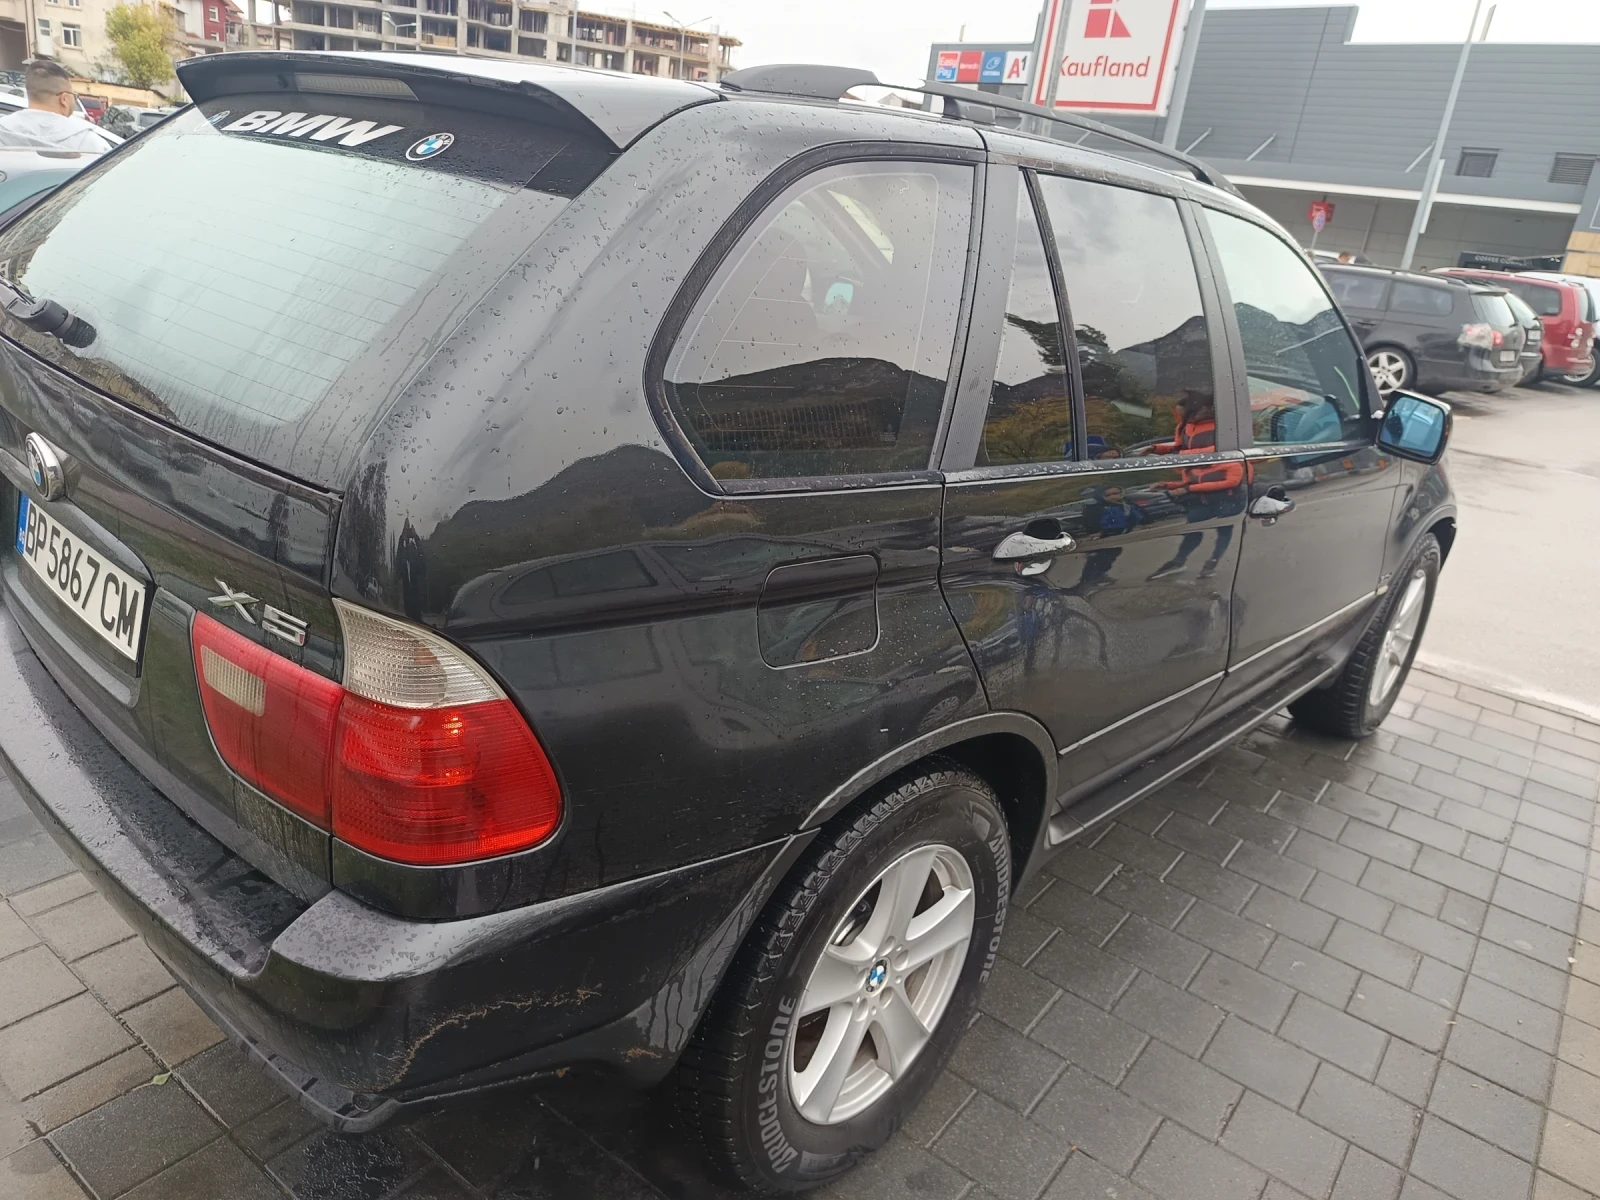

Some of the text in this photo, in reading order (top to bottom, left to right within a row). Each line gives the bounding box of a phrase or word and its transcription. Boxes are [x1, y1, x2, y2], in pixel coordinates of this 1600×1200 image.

[220, 110, 404, 147] BMW
[25, 503, 139, 649] BP 5867 CM
[208, 577, 311, 647] X5
[758, 996, 798, 1173] BRIDGESTONE
